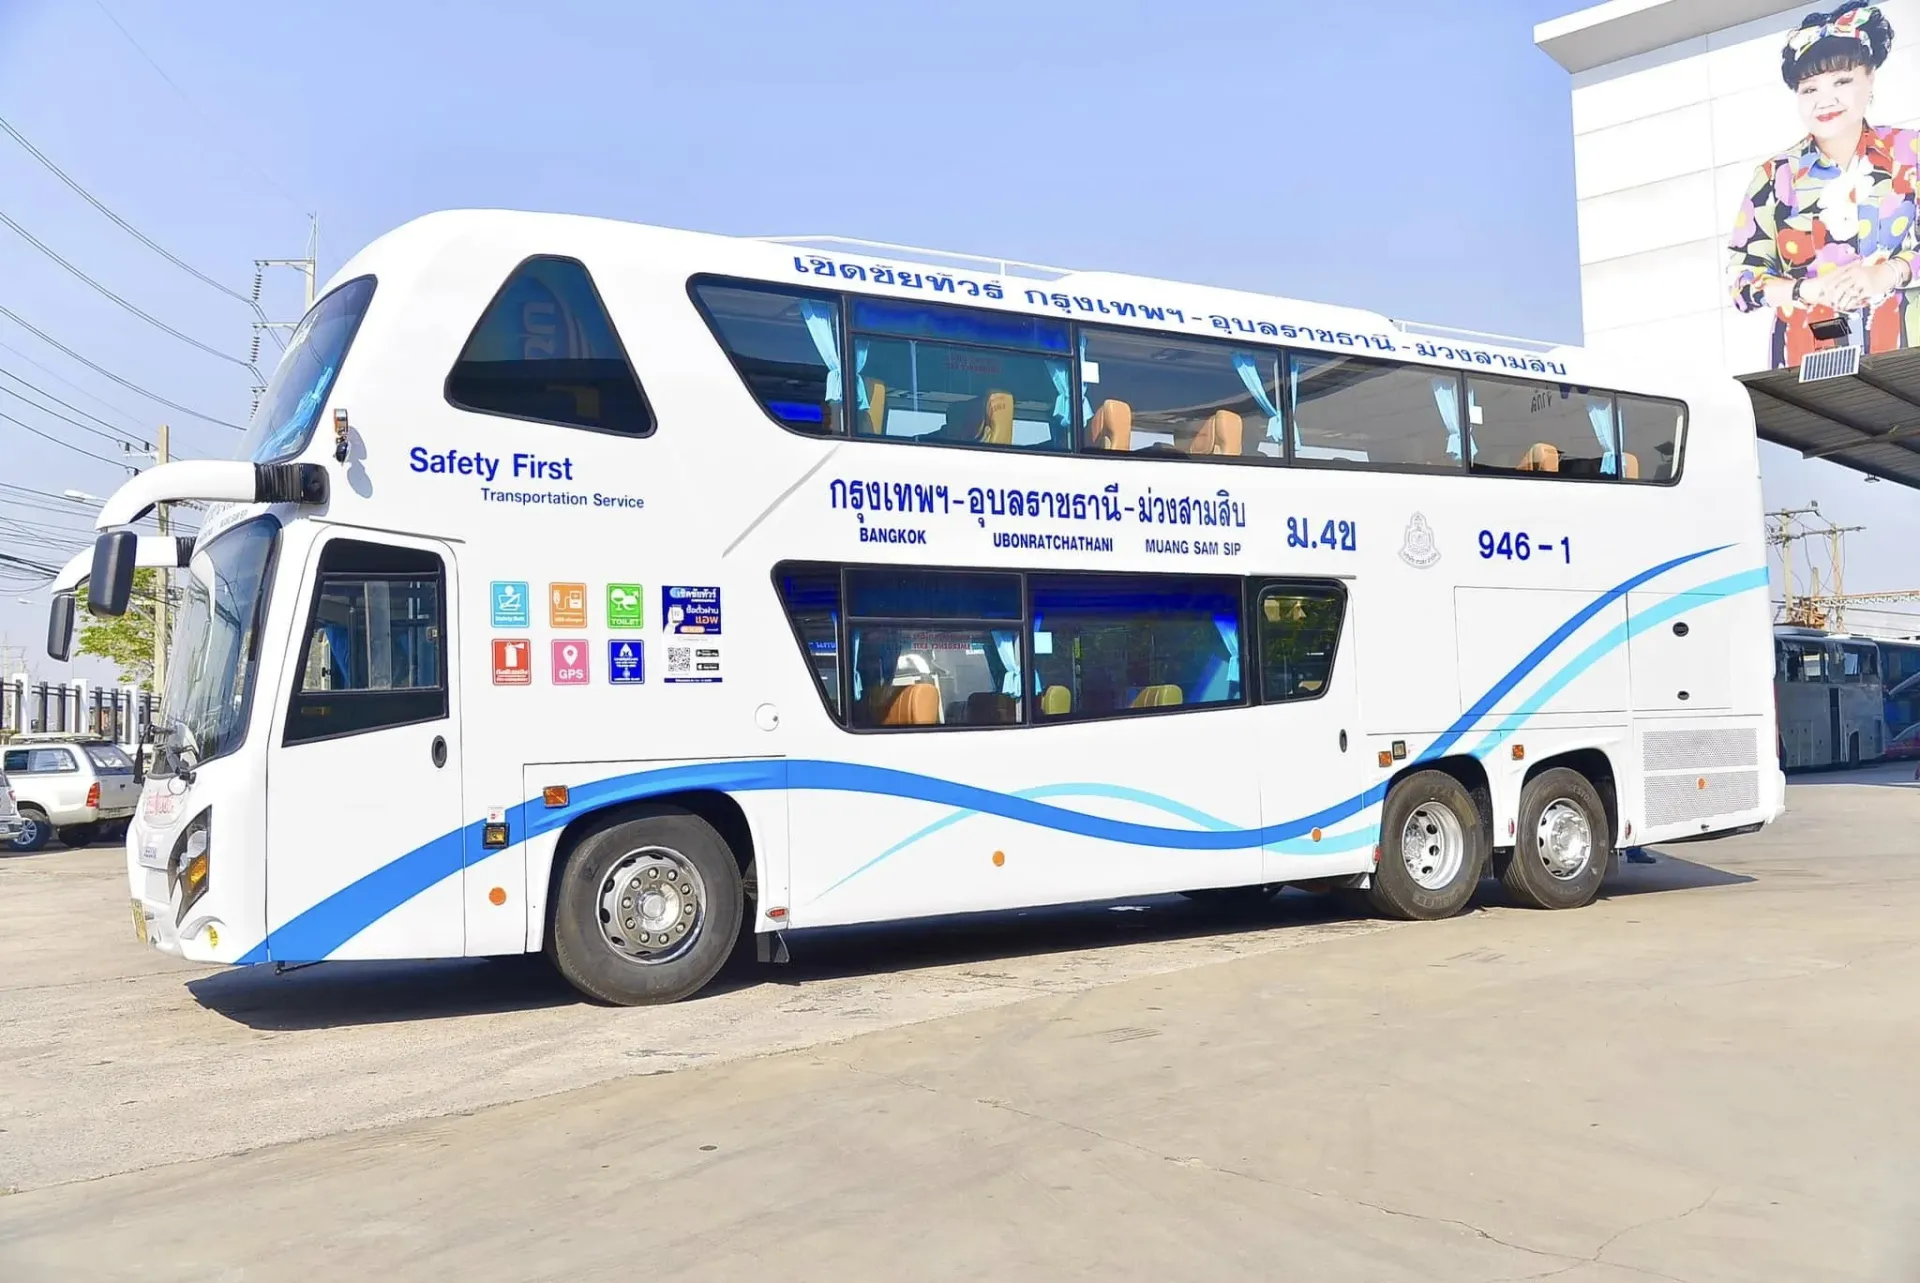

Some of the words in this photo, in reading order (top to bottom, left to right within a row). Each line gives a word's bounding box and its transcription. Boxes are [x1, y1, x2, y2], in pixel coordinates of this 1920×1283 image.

[409, 446, 500, 482] Safety
[513, 453, 573, 481] First
[481, 488, 588, 506] Transportation
[593, 493, 645, 508] Service
[859, 527, 927, 545] BANGKOK
[993, 532, 1114, 553] UBONRATCHATHANI
[1145, 539, 1190, 555] MUANG
[1194, 541, 1219, 555] SAM
[1223, 543, 1242, 556] SIP
[559, 668, 584, 680] GPS
